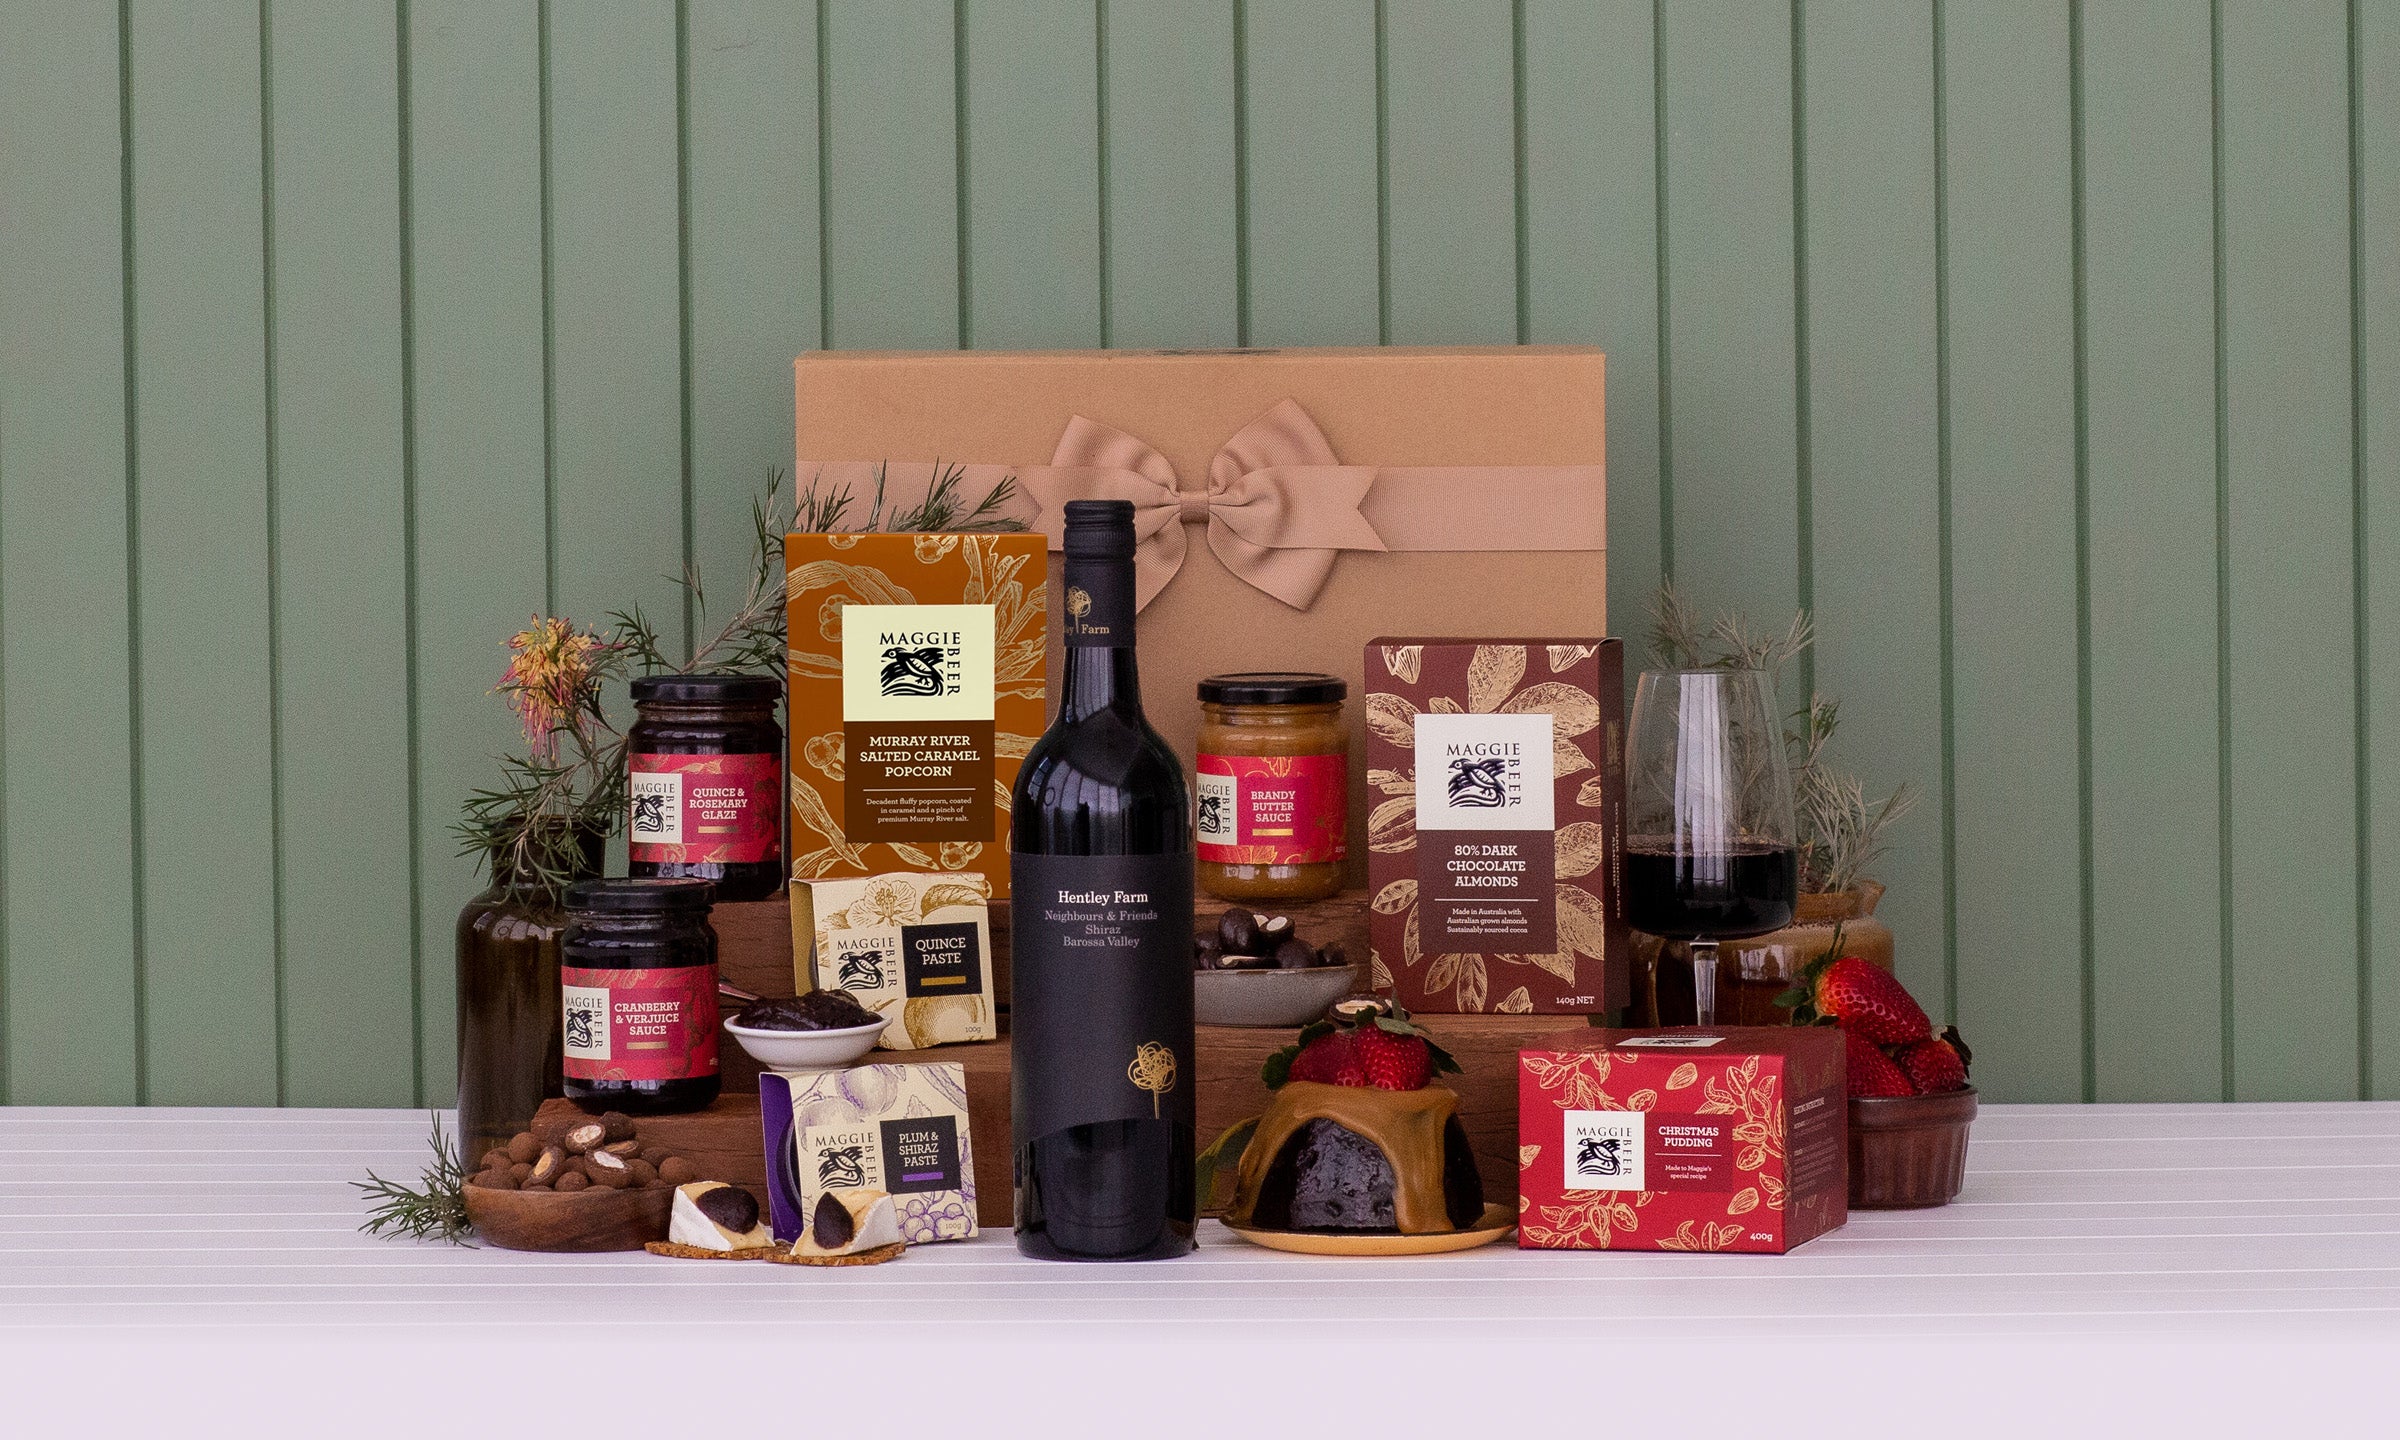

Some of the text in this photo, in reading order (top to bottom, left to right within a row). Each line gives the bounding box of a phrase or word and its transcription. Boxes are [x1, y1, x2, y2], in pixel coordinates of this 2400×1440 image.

[1081, 625, 1110, 634] Farm
[879, 632, 961, 645] MAGGIE
[947, 648, 961, 696] BEER
[869, 735, 970, 747] MURRAY RIVER
[1446, 742, 1520, 756] MAGGIE
[860, 750, 980, 762] SALTED CARAMEL
[885, 766, 952, 777] POPCORN
[634, 783, 675, 793] MAGGIE
[1508, 759, 1521, 808] BEER
[692, 787, 745, 797] QUINCE &
[1251, 791, 1296, 800] BRANDY
[689, 799, 748, 809] ROSEMARY
[899, 797, 918, 806] fluffy
[919, 798, 948, 807] popcorn,
[1252, 802, 1295, 811] BUTTER
[665, 795, 675, 832] BEER
[701, 810, 737, 820] GLAZE
[888, 806, 916, 814] caramel
[917, 806, 929, 814] and
[936, 806, 955, 815] pinch
[1222, 798, 1231, 834] BEER
[877, 816, 908, 824] premium
[910, 815, 934, 824] Murray
[1255, 814, 1292, 822] SAUCE
[1454, 845, 1518, 856] 80% DARK
[1446, 861, 1526, 872] CHOCOLATE
[1455, 876, 1518, 887] ALMONDS
[1058, 890, 1148, 906] Hentley Farm
[1044, 910, 1158, 923] Neighbours & Friends
[1480, 918, 1501, 926] grown
[1085, 924, 1121, 935] Shiraz
[1446, 926, 1483, 934] Sustainably
[837, 937, 895, 950] MAGGIE
[915, 937, 966, 951] QUINCE
[1063, 936, 1140, 949] Barossa Valley
[922, 953, 962, 966] PASTE
[885, 950, 898, 987] BEER
[565, 996, 603, 1009] MAGGIE
[1556, 996, 1595, 1005] 140g NET
[614, 1002, 680, 1012] CRANBERRY
[615, 1013, 679, 1024] & VERJUICE
[594, 1010, 603, 1048] BEER
[629, 1026, 667, 1036] SAUCE
[1576, 1127, 1633, 1137] MAGGIE
[1658, 1126, 1719, 1137] CHRISTMAS
[815, 1132, 874, 1147] MAGGIE
[899, 1131, 939, 1144] PLUM &
[1664, 1137, 1713, 1148] PUDDING
[899, 1143, 939, 1156] SHIRAZ
[904, 1155, 938, 1167] PASTE
[1622, 1139, 1633, 1176] BEER
[865, 1145, 877, 1185] BEER
[1688, 1165, 1712, 1173] Maggie's
[1750, 1233, 1773, 1242] 400g
